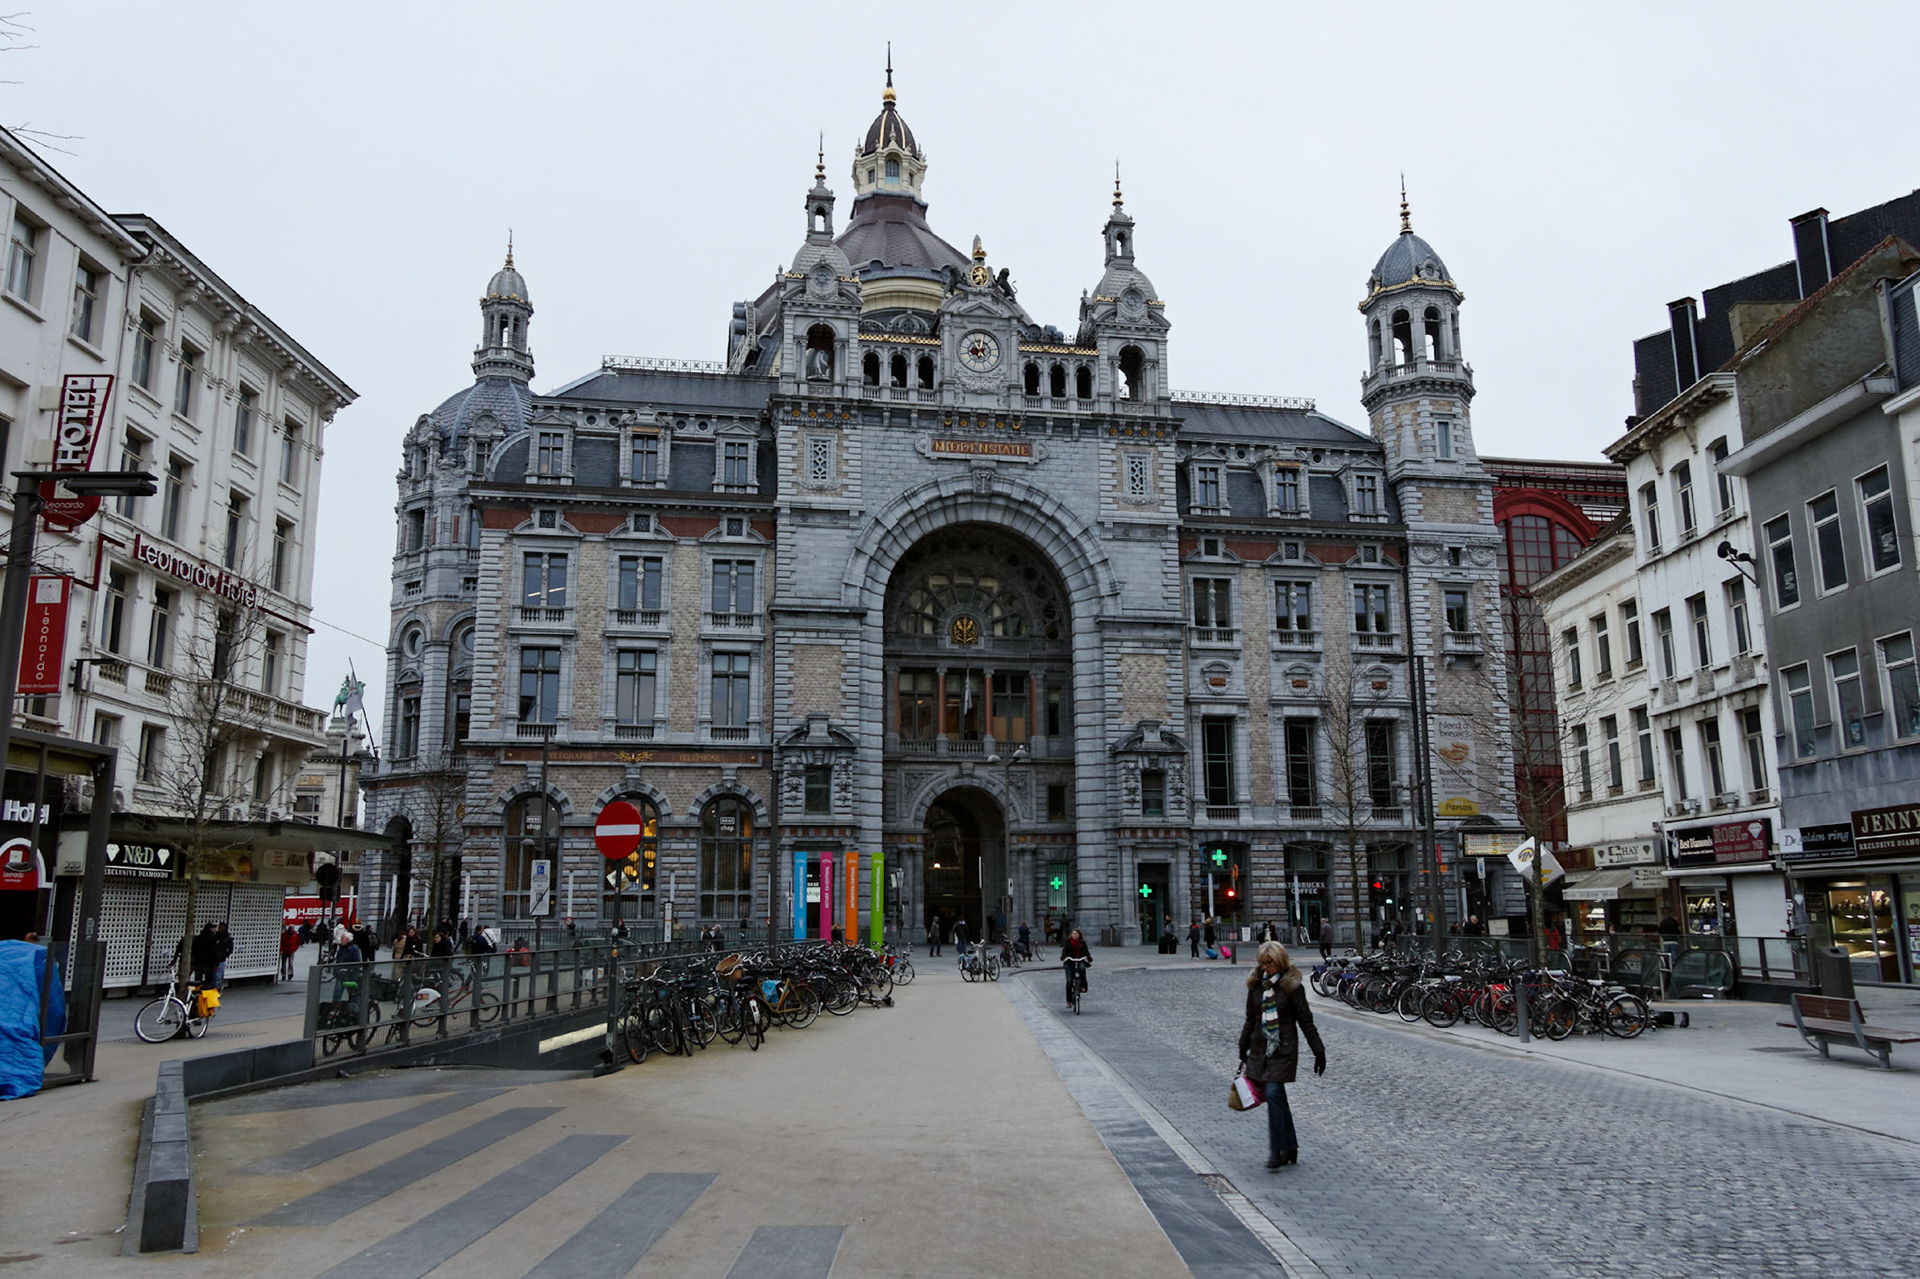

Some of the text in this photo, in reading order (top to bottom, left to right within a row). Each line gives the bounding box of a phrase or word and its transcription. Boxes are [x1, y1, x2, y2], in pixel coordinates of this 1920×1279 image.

[55, 377, 93, 464] HOTEL
[935, 441, 1028, 456] MIDDENSTATIE
[137, 534, 260, 609] Leonardo Hotel
[36, 606, 50, 680] Leonardo
[1439, 721, 1461, 729] Need
[1439, 729, 1469, 738] break?
[1446, 803, 1473, 811] Panos
[1861, 810, 1920, 833] JENNY
[1828, 829, 1849, 843] ring
[1859, 840, 1895, 850] EXCLUSIVE
[123, 845, 154, 865] N&D
[104, 868, 168, 879] EXCLUSIVE DIAMONDS
[298, 907, 343, 916] H.ESSES
